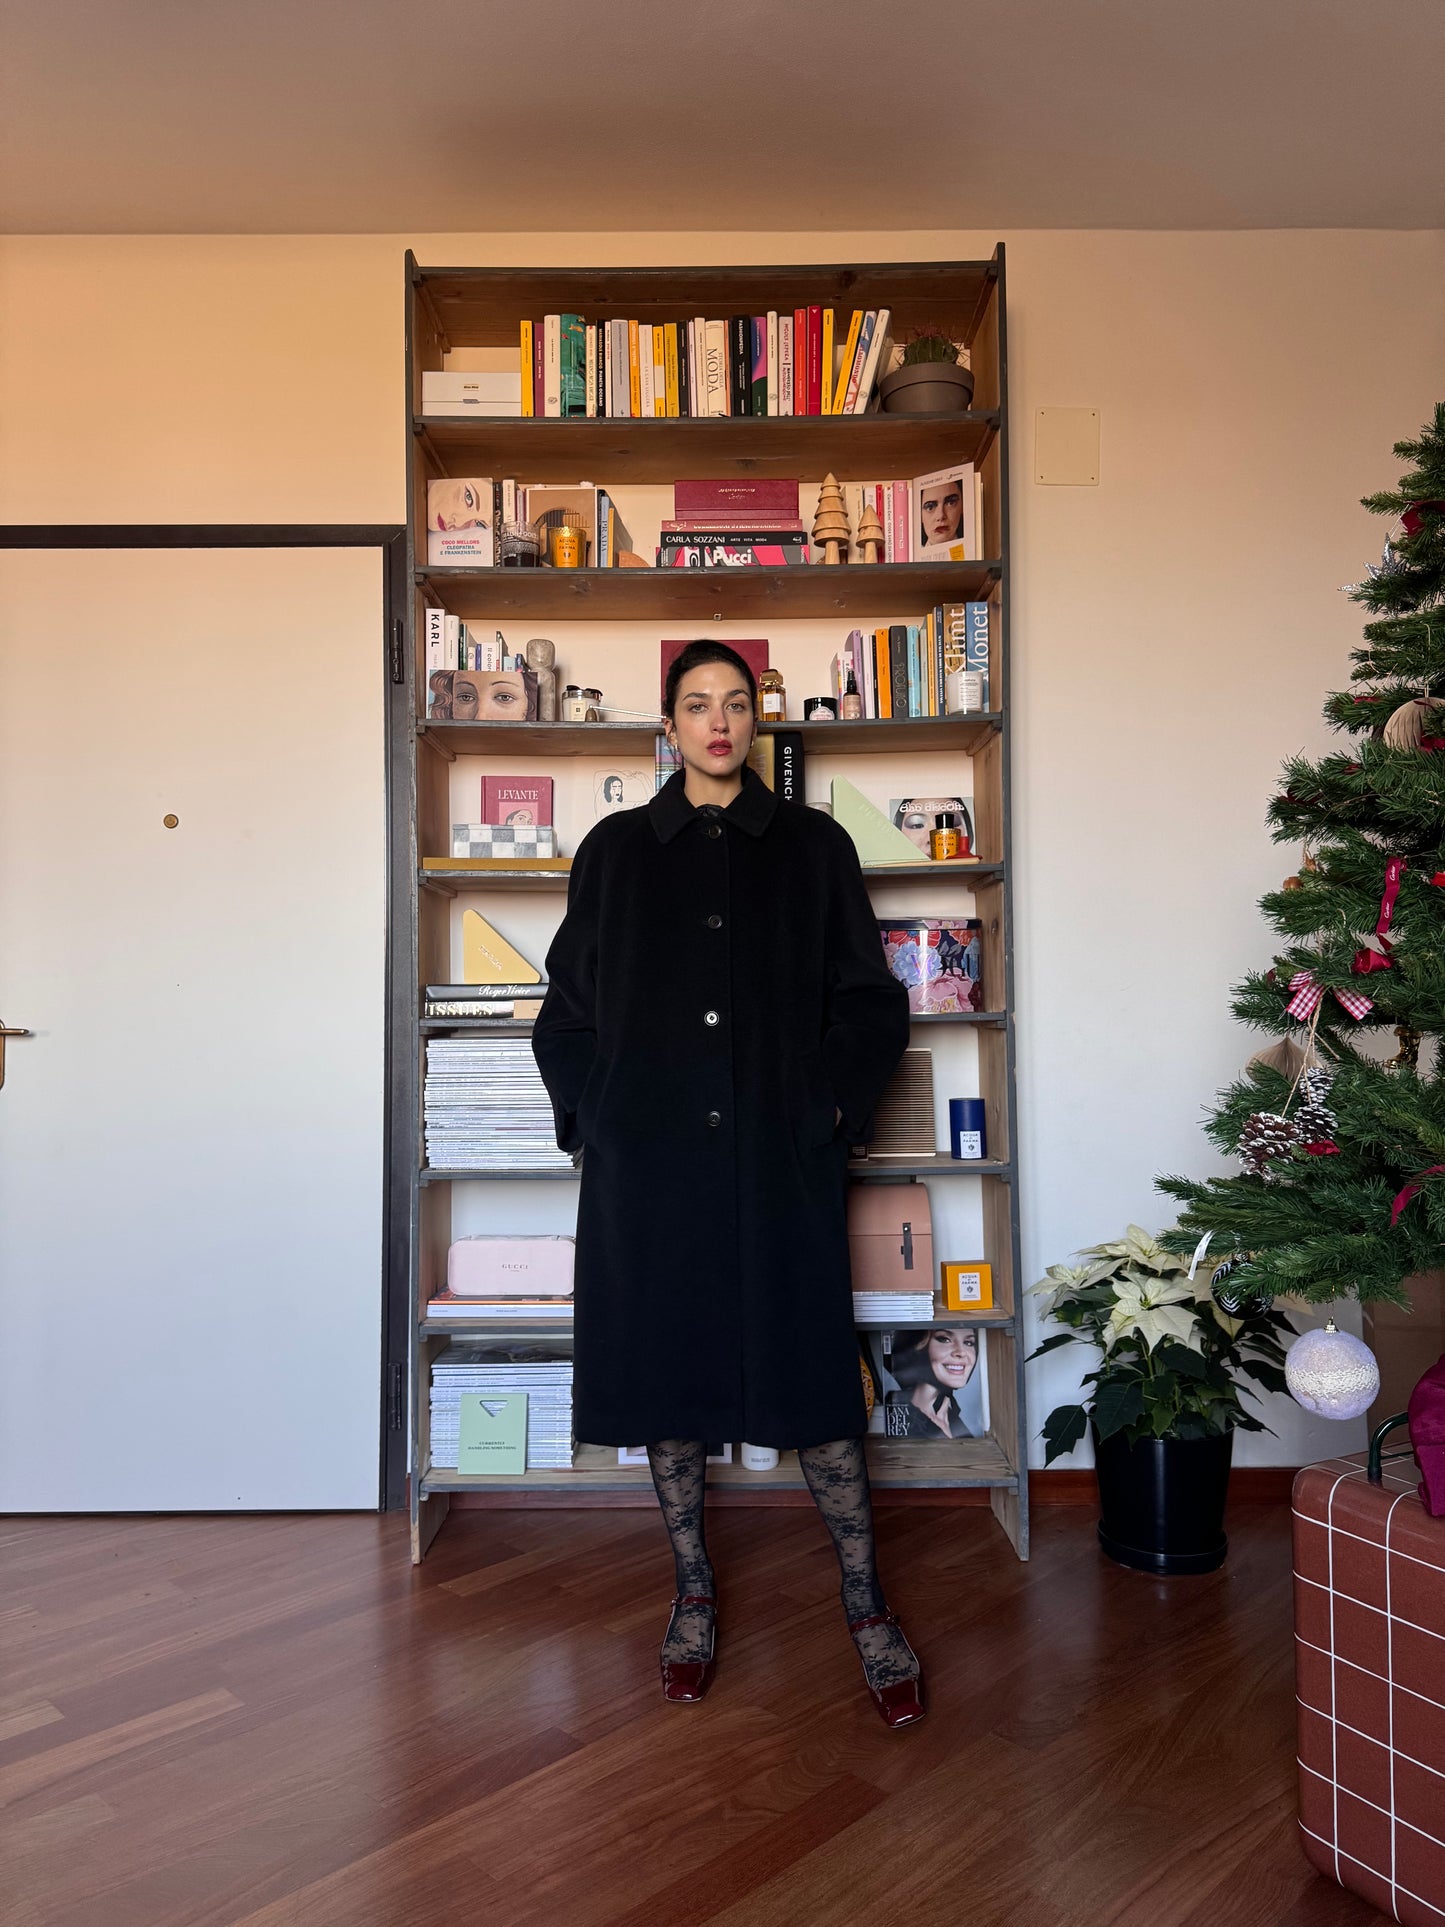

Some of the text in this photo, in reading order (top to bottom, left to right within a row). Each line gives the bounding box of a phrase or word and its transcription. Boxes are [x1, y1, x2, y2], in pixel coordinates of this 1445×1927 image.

[707, 348, 718, 394] MODA
[713, 548, 752, 564] Pucci
[431, 614, 440, 647] KARL
[945, 608, 966, 674] Klimt
[968, 606, 988, 682] Monet
[498, 789, 539, 800] LEVANTE
[478, 985, 530, 997] Roger Vivier
[429, 1004, 493, 1016] ISSUES
[886, 1406, 910, 1416] LANA
[887, 1415, 907, 1425] DEL
[887, 1423, 910, 1436] REY
